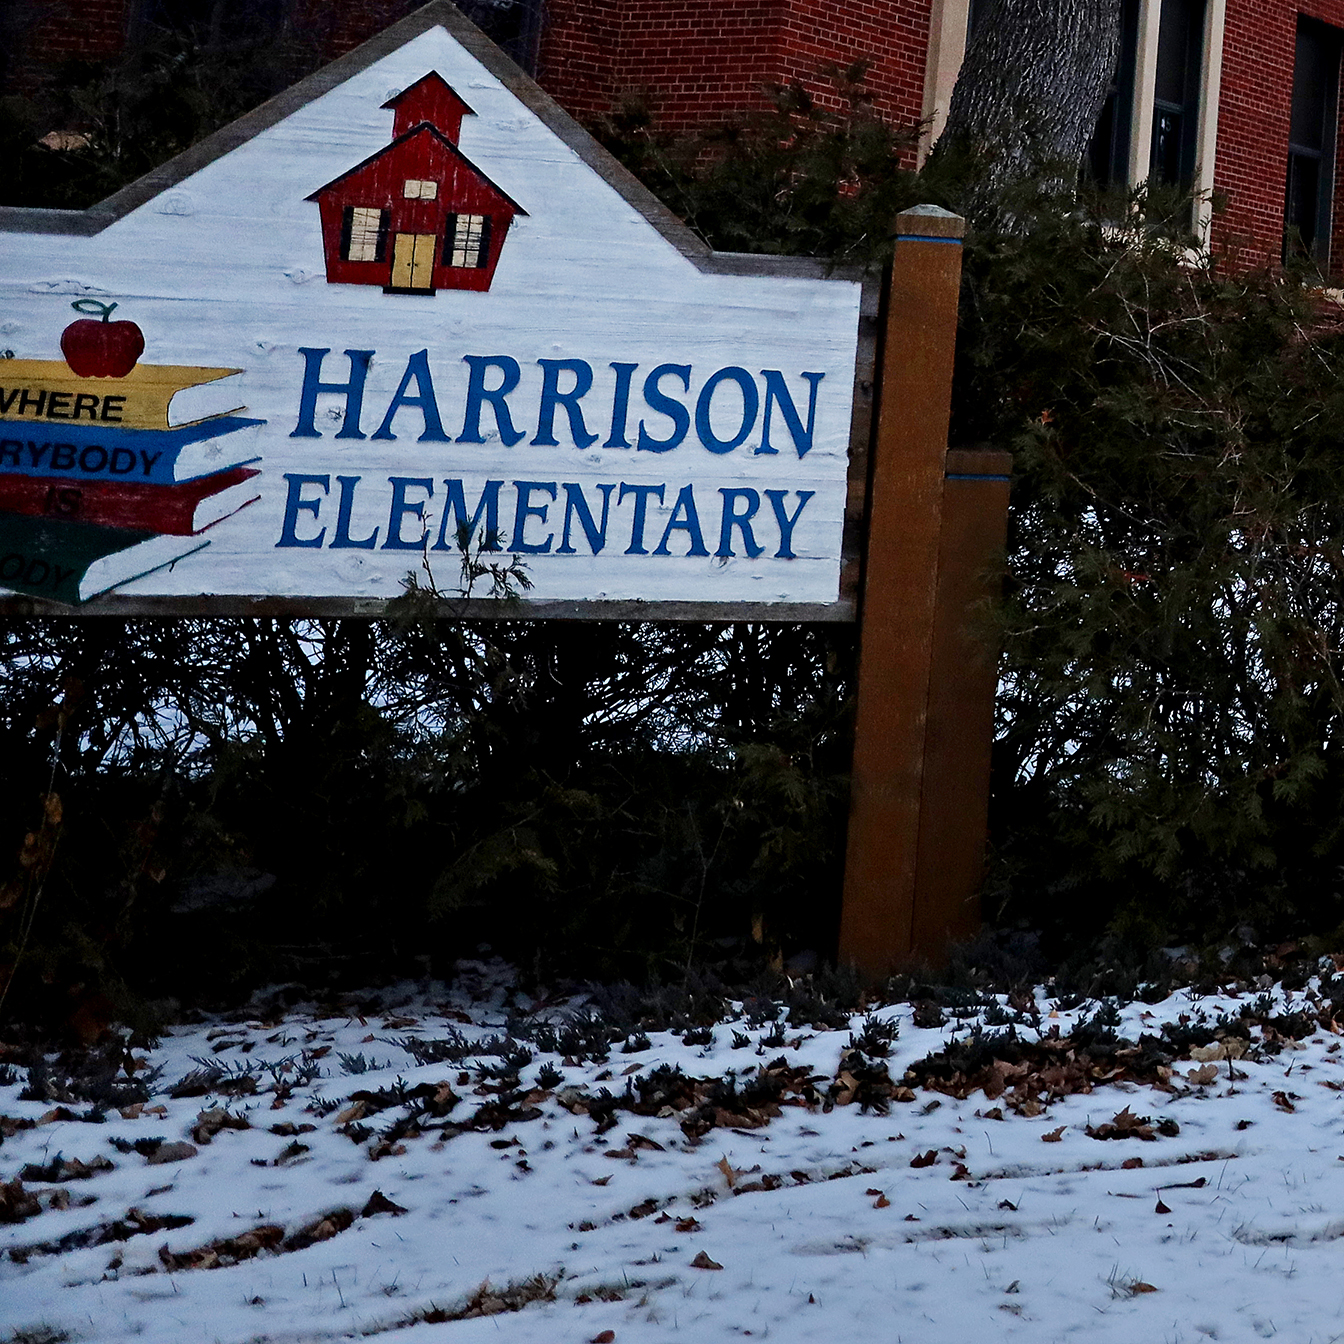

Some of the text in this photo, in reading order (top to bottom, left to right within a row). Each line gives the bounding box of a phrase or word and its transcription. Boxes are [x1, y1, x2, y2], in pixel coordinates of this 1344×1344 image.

[288, 346, 826, 459] HARRISON
[44, 485, 83, 516] IS
[274, 472, 815, 559] ELEMENTARY
